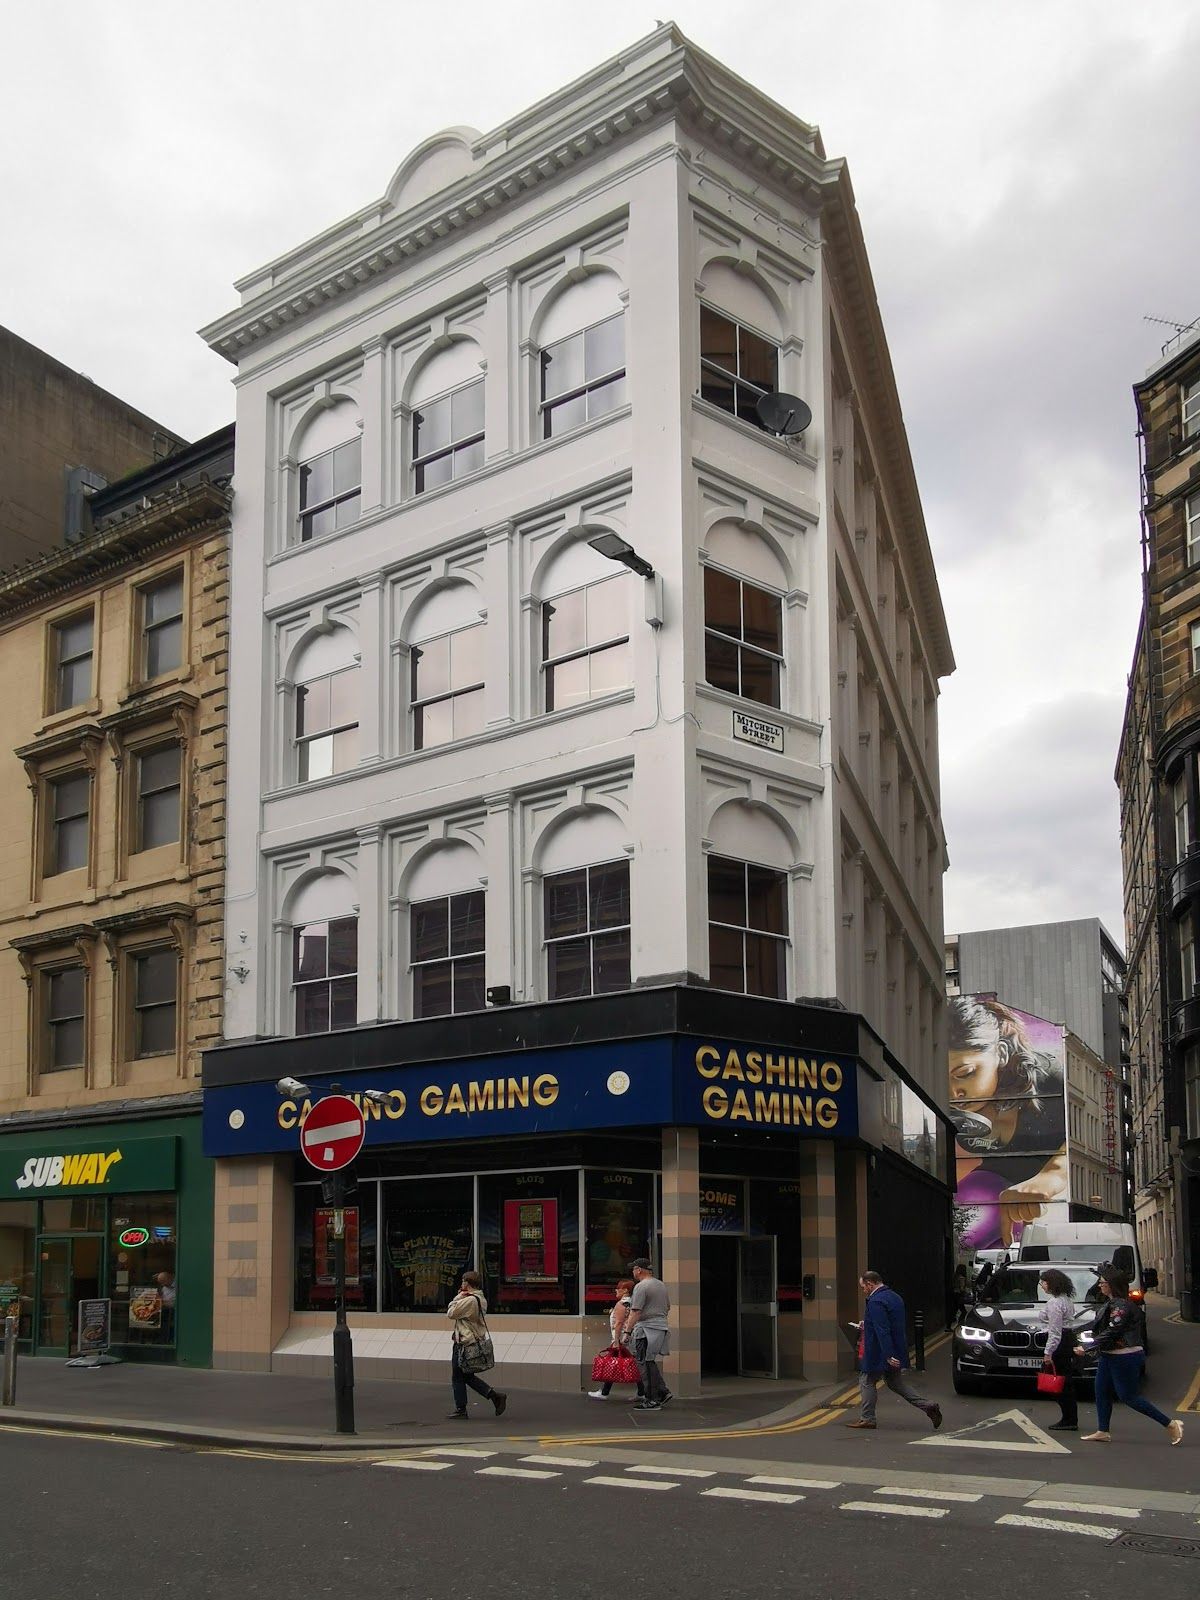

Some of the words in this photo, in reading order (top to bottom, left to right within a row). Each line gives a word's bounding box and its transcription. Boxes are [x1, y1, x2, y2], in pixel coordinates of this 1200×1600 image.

[737, 715, 780, 736] MITCHELL
[742, 726, 775, 743] STREET
[694, 1045, 843, 1092] CASHINO
[277, 1089, 407, 1129] CAINO
[419, 1073, 559, 1117] GAMING
[702, 1085, 839, 1129] GAMING
[16, 1148, 123, 1189] SUBWAY
[516, 1175, 546, 1185] SLOTS
[602, 1174, 634, 1185] SLOTS
[122, 1232, 144, 1242] OPEN
[403, 1235, 431, 1249] PLAY
[432, 1235, 455, 1249] THE
